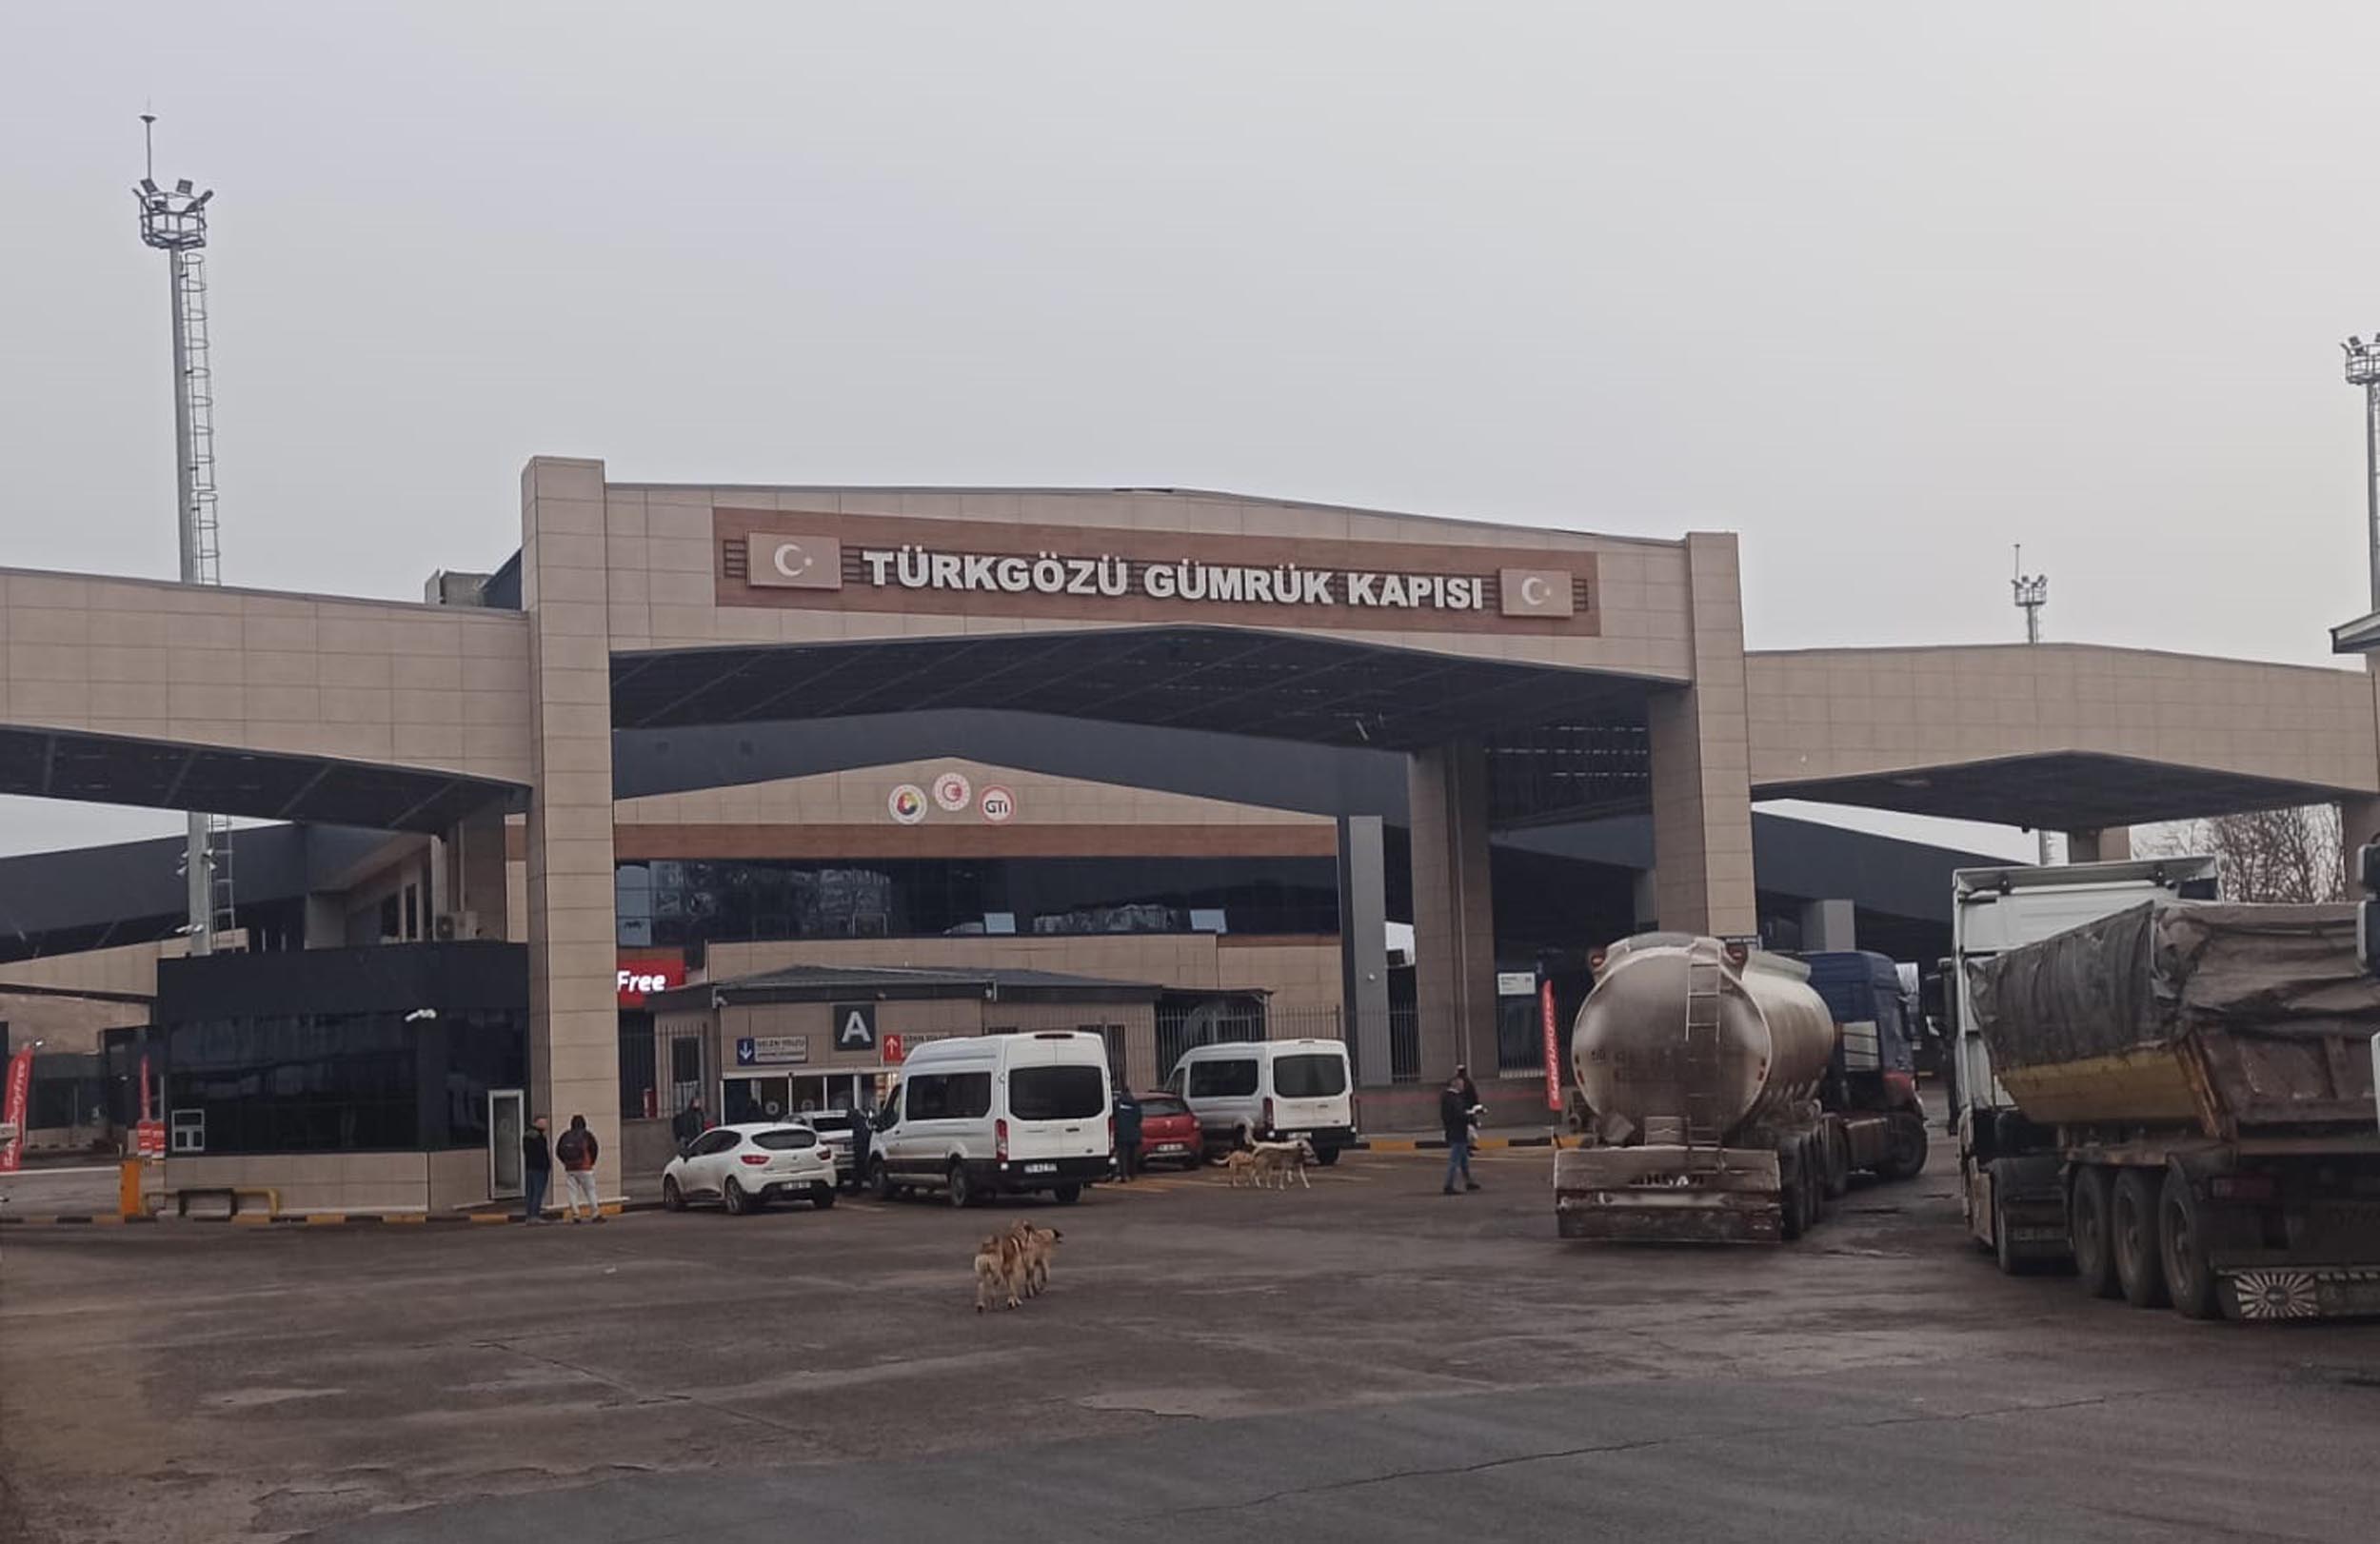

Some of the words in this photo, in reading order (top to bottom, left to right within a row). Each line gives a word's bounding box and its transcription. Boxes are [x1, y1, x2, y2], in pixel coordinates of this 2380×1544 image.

[863, 544, 1129, 597] TÜRKGÖZÜ
[1143, 557, 1335, 604] GÜMRÜK
[1347, 571, 1484, 610] KAPISI
[617, 970, 666, 993] Free
[841, 1010, 872, 1043] A
